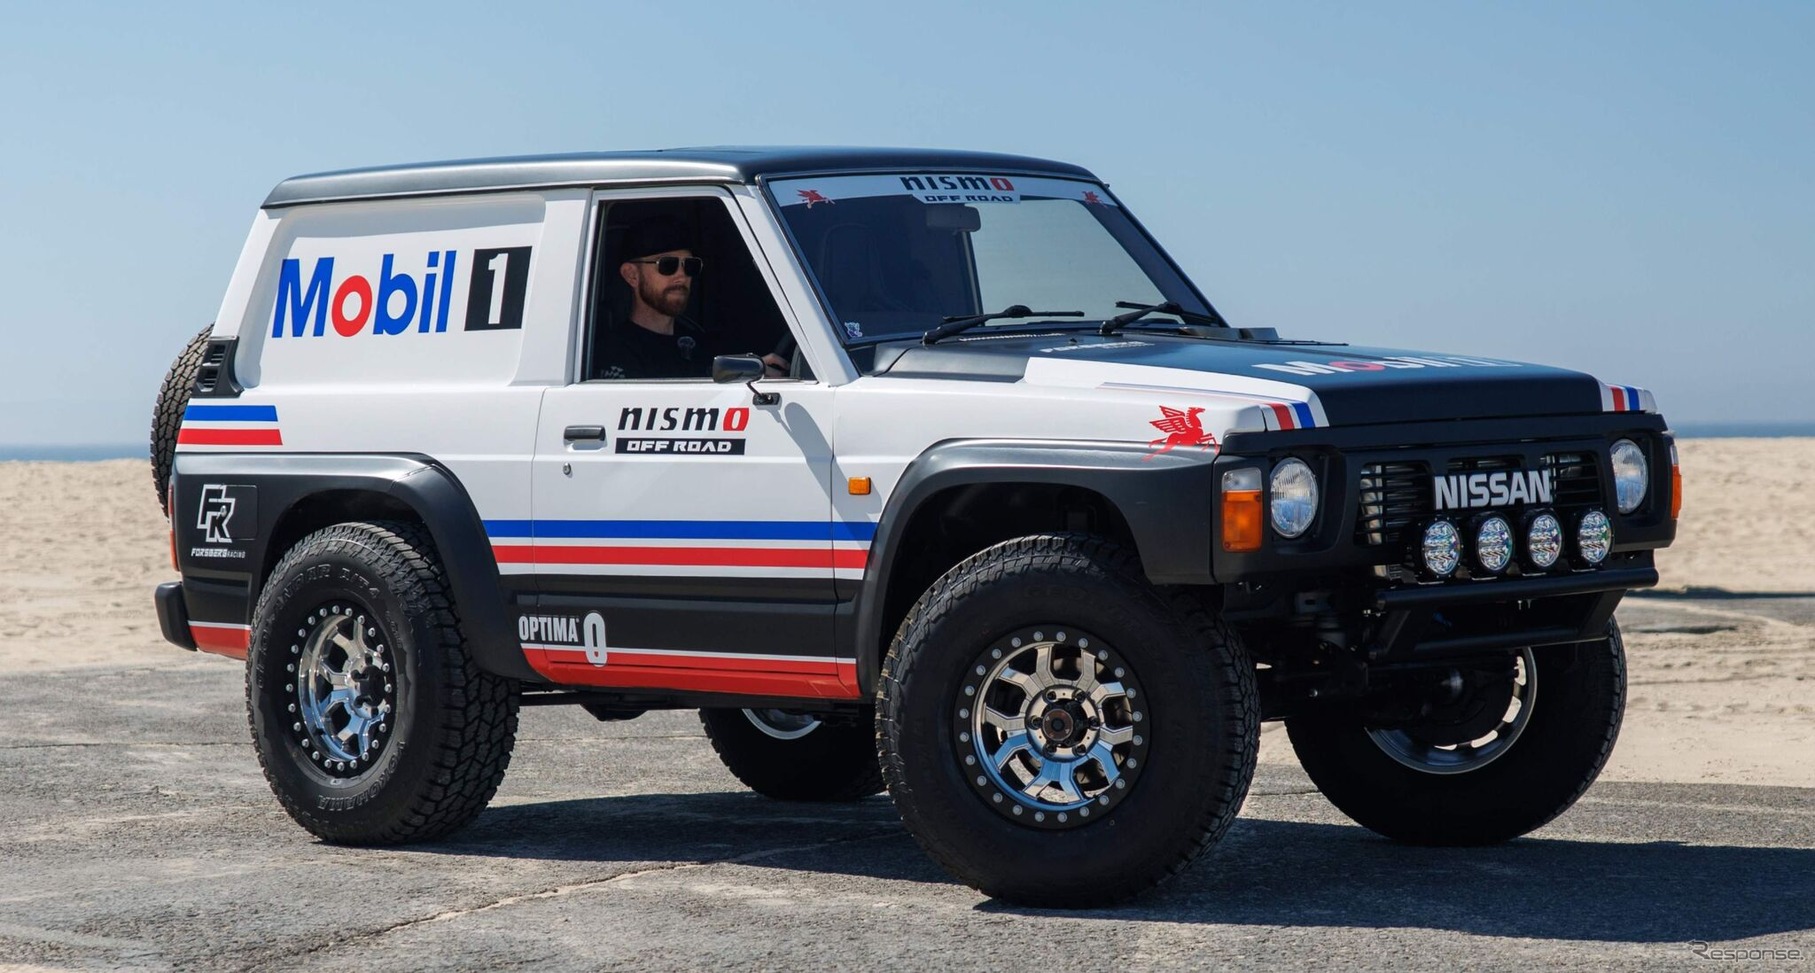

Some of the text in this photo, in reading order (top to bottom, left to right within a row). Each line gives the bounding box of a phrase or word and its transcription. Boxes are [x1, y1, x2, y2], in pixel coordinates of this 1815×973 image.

[899, 176, 1015, 191] nismo
[272, 250, 508, 338] Mobil 1
[617, 407, 750, 431] nismo
[626, 440, 732, 452] OFF ROAD
[1434, 470, 1551, 510] NISSAN
[518, 615, 579, 642] OPTIMA
